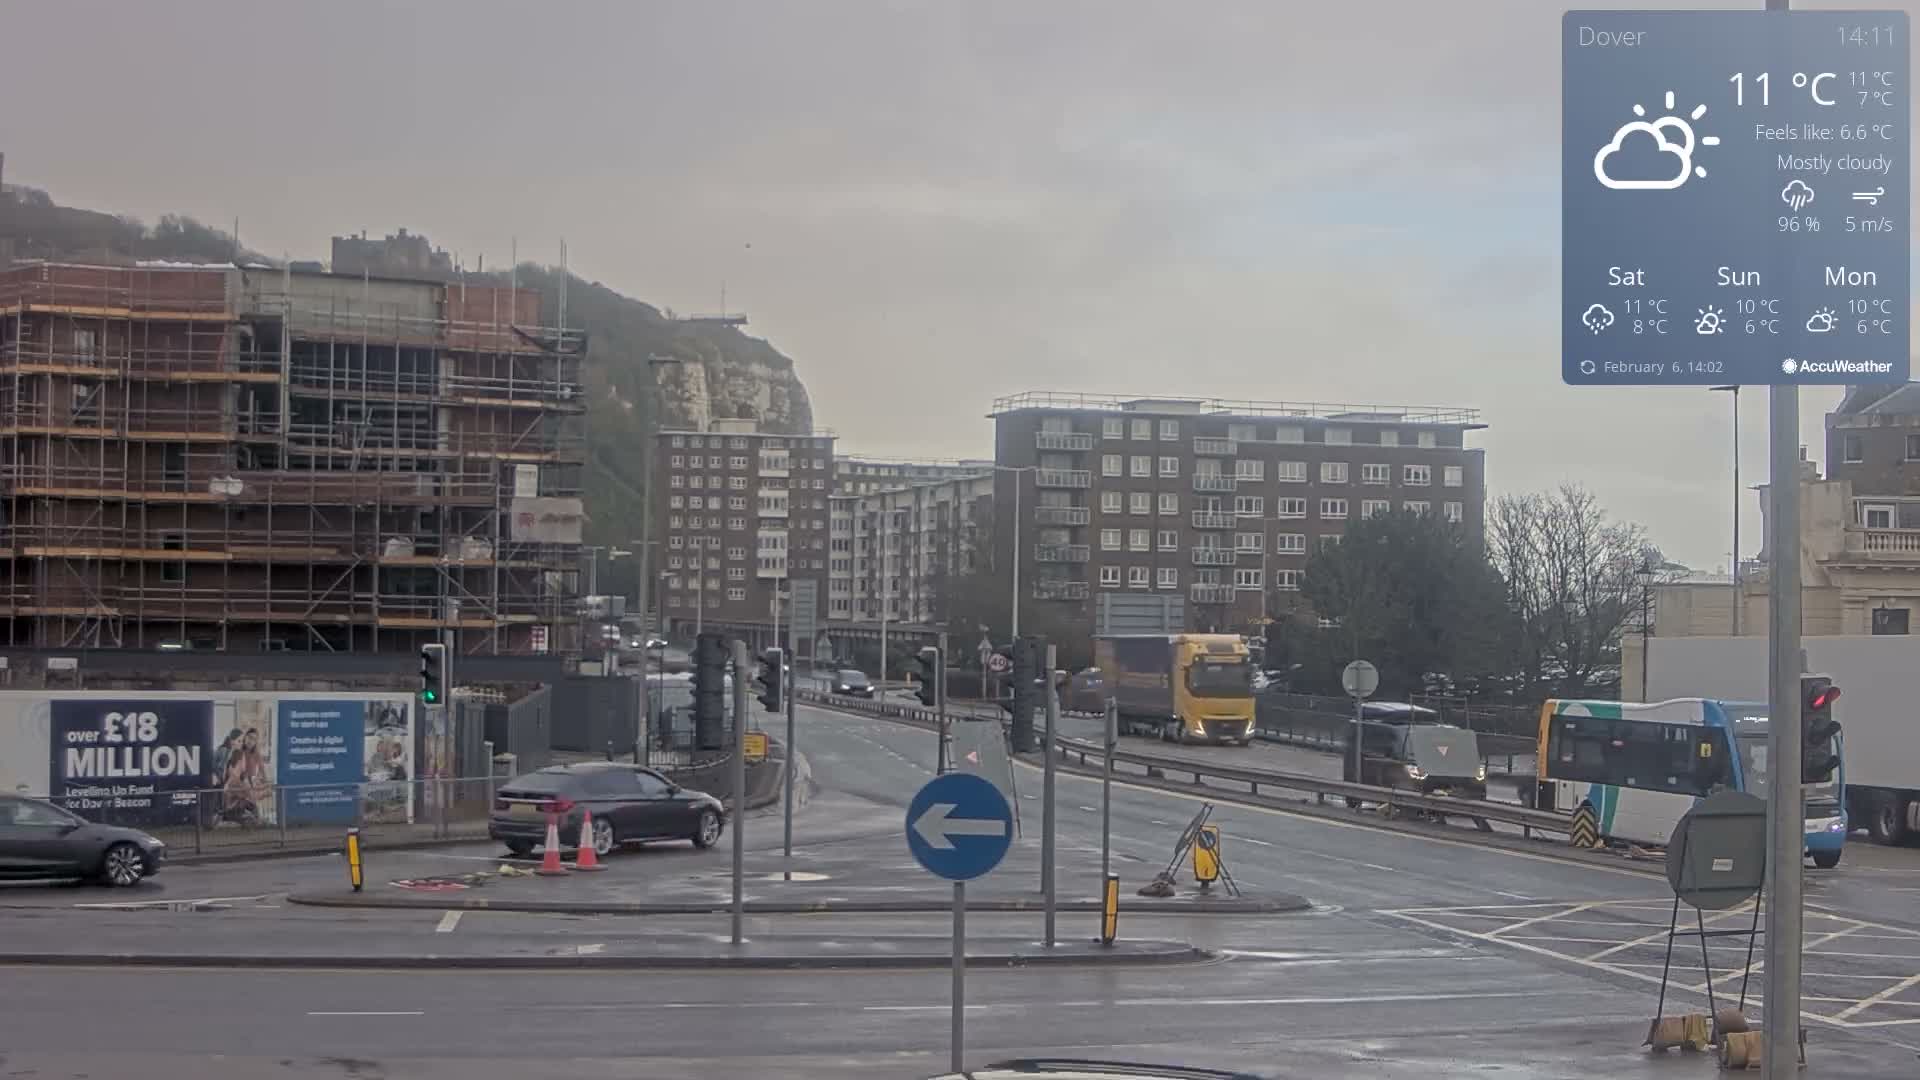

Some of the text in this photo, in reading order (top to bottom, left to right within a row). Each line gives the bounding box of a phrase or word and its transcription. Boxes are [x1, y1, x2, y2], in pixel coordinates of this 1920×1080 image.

[990, 656, 1006, 666] 40
[67, 711, 158, 742] over £18
[66, 745, 200, 778] MILLION
[129, 784, 154, 796] Fund
[115, 797, 151, 808] Beacon
